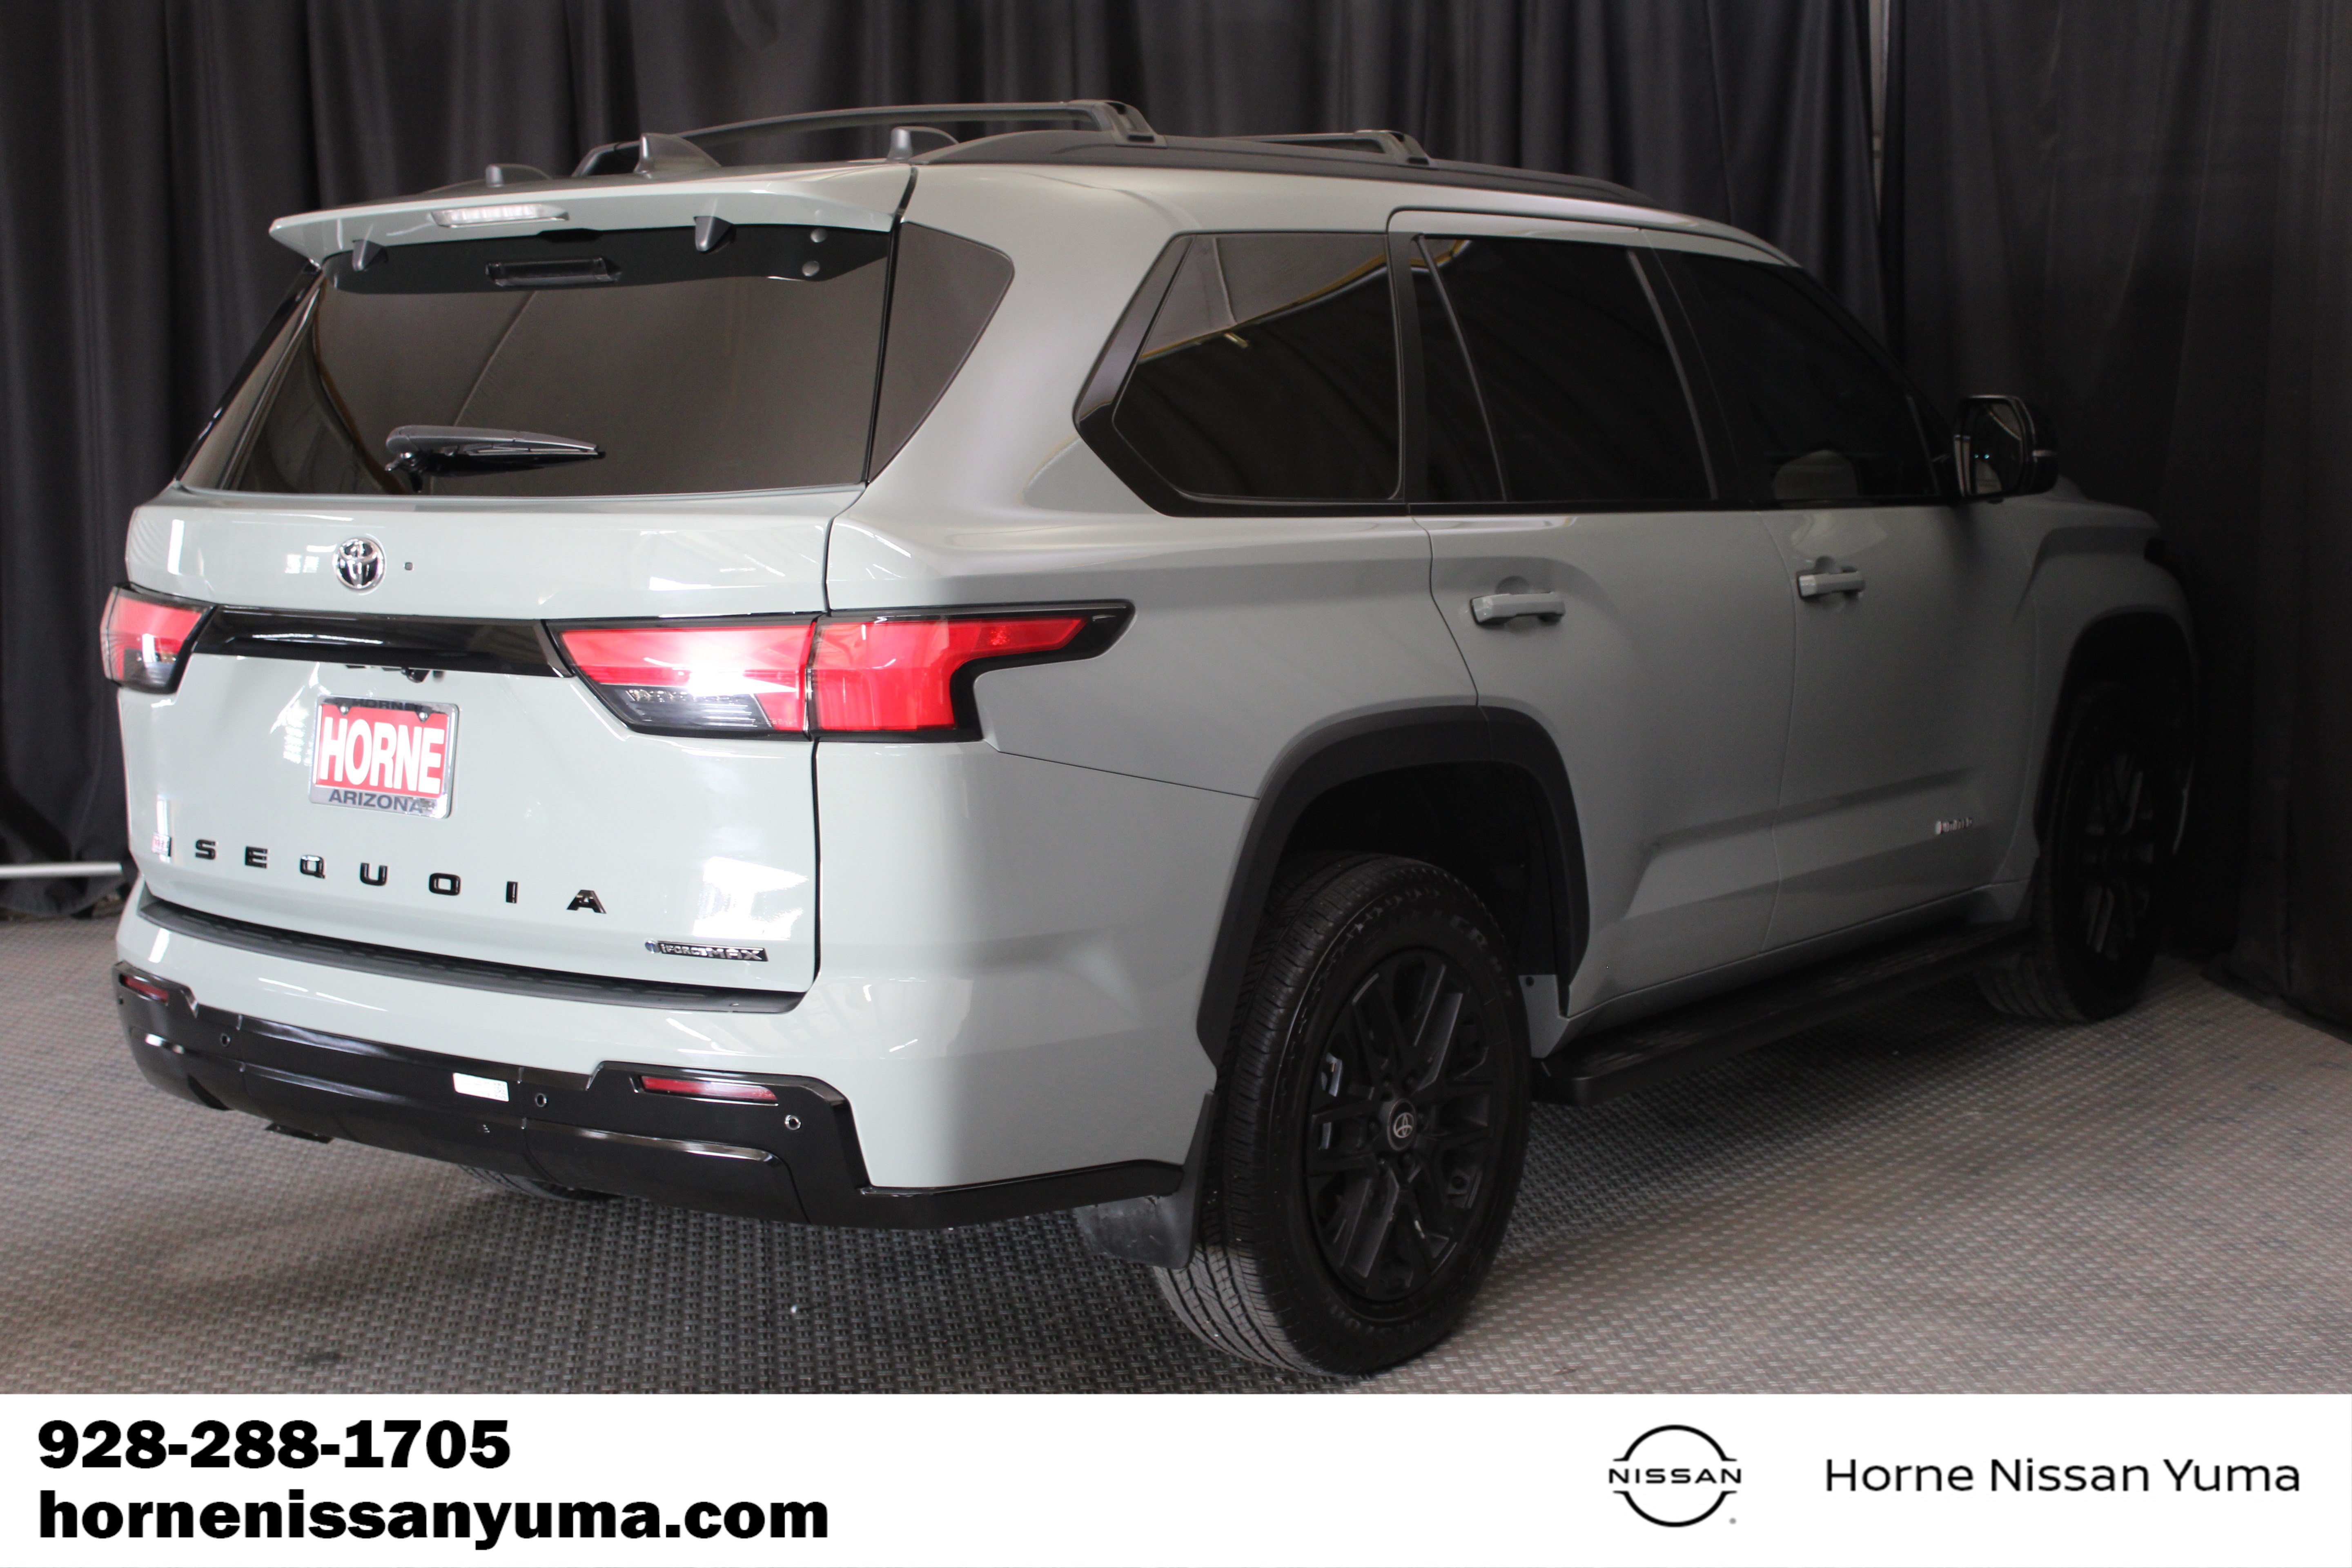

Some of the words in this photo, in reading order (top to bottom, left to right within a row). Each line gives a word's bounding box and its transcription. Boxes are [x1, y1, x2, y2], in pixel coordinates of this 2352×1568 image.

[320, 716, 445, 794] HORNE
[328, 789, 423, 813] ARIZONA
[195, 839, 606, 913] SEQUOIA
